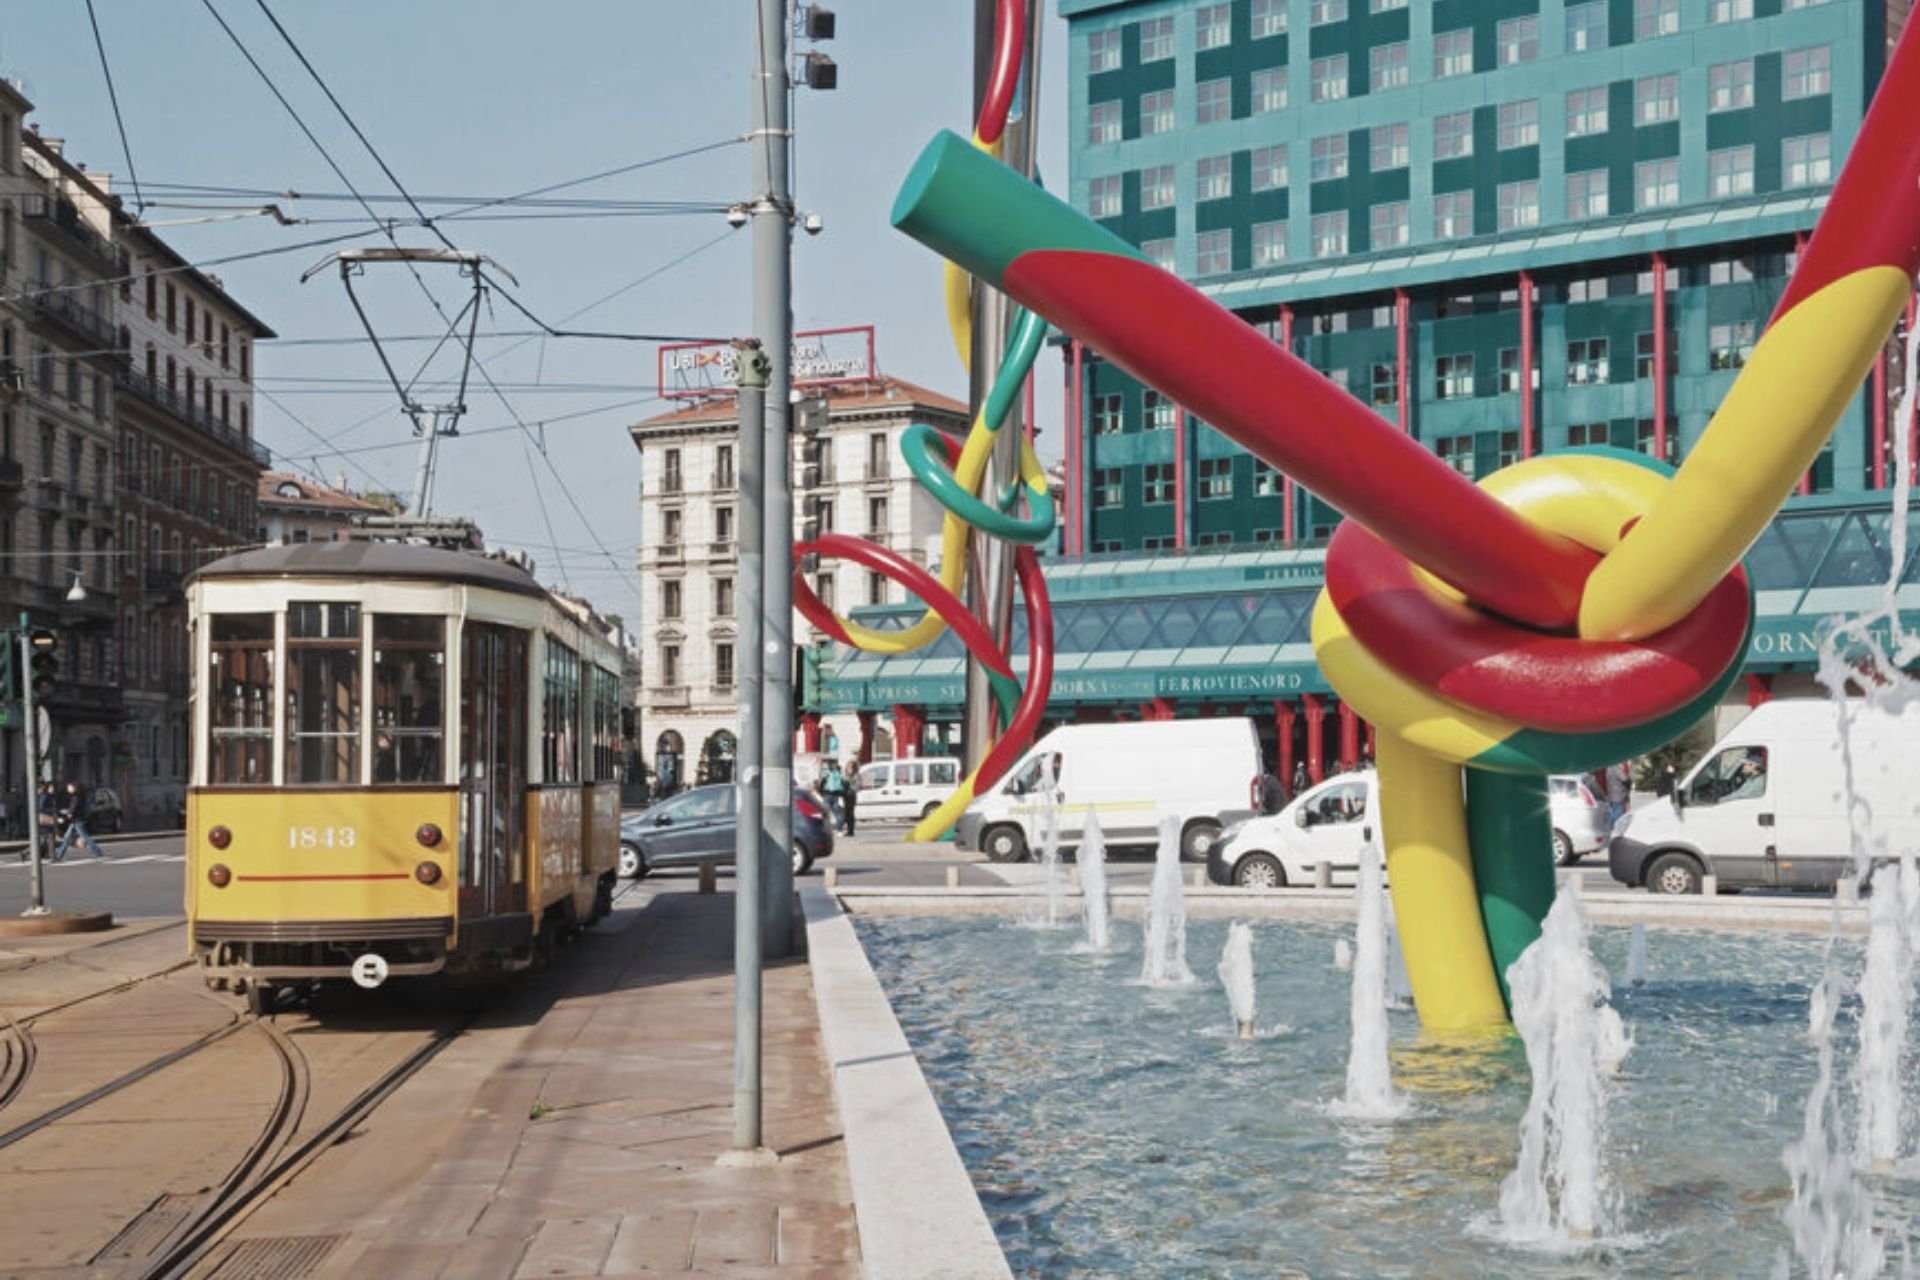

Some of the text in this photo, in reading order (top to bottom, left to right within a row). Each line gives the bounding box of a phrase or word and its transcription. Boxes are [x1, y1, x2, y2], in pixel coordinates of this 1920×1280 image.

[1753, 632, 1819, 653] ORN
[1054, 679, 1108, 695] DORNA
[1159, 674, 1302, 692] FERROVIENORD
[288, 825, 356, 849] 1843
